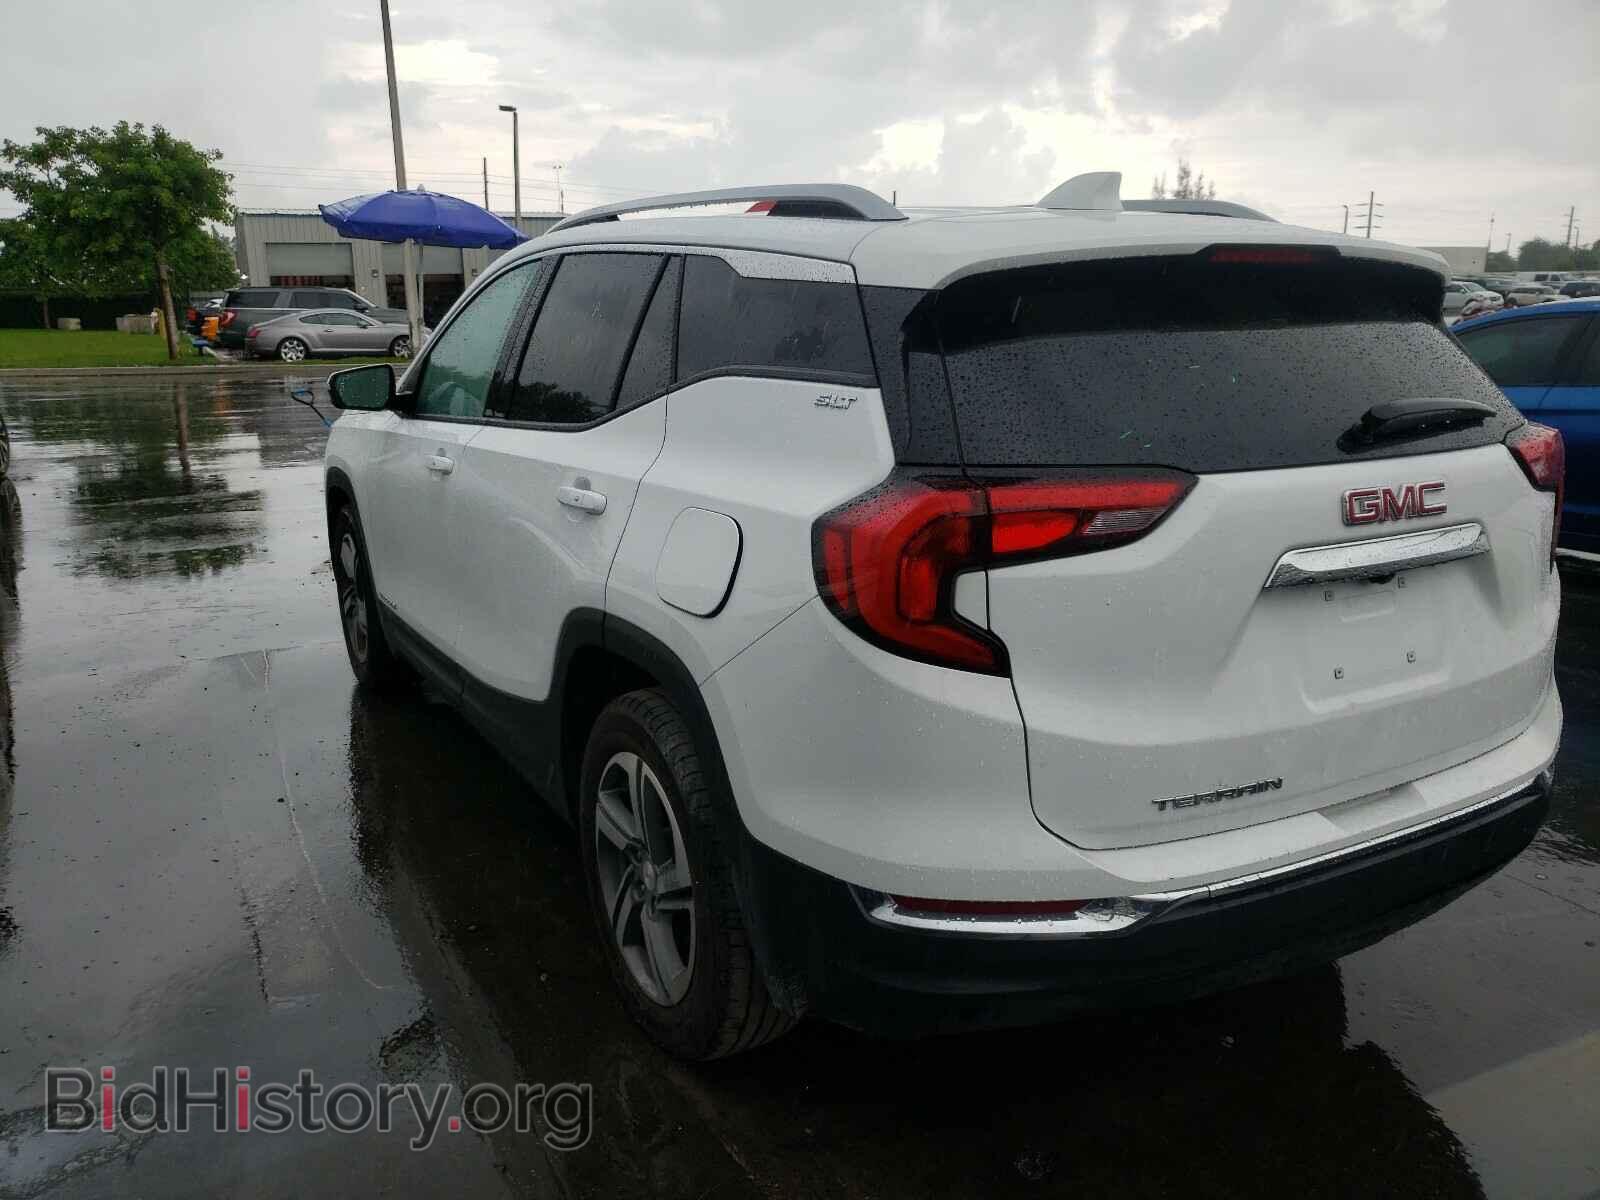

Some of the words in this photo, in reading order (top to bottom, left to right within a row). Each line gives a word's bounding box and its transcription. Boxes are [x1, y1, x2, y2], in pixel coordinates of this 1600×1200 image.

[813, 394, 858, 410] SLT
[1342, 480, 1447, 526] GMC
[1152, 777, 1283, 811] TERRAIN
